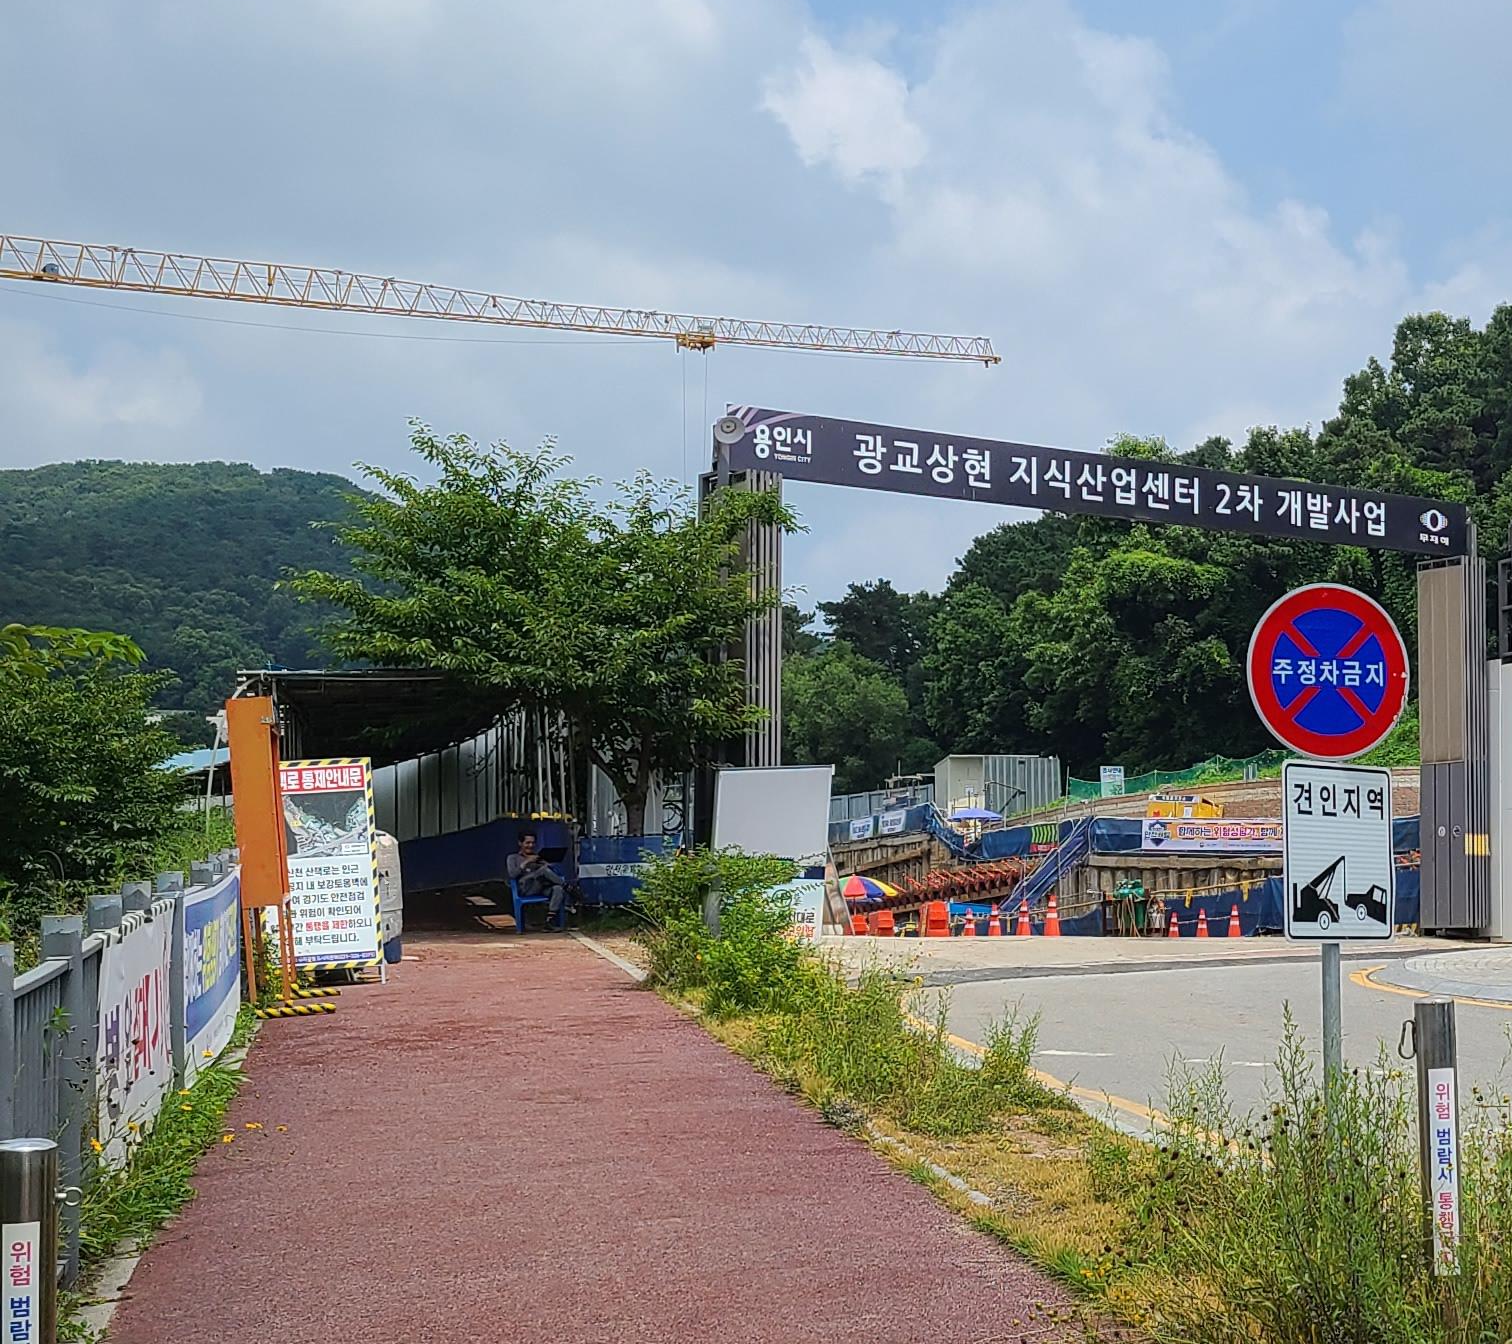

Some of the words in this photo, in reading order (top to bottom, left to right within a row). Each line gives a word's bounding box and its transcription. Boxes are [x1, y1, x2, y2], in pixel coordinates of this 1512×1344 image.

[753, 424, 812, 459] 용인시
[853, 434, 991, 489] 광교상현
[1009, 456, 1200, 514] 지식산업센터
[1216, 483, 1264, 522] 2차
[1276, 489, 1387, 536] 개발사업
[1272, 658, 1385, 687] 주정차금지
[302, 766, 361, 790] 통제안내문
[1293, 782, 1384, 820] 견인지역
[303, 893, 329, 905] 경기도
[330, 891, 365, 903] 안전점검
[306, 881, 315, 891] 내
[299, 907, 325, 919] 위험이
[328, 905, 362, 917] 확인되어
[305, 932, 360, 946] 부탁드립니다.
[1435, 1082, 1451, 1120] 위험
[1436, 1127, 1453, 1184] 범람시
[9, 1240, 32, 1287] 위험
